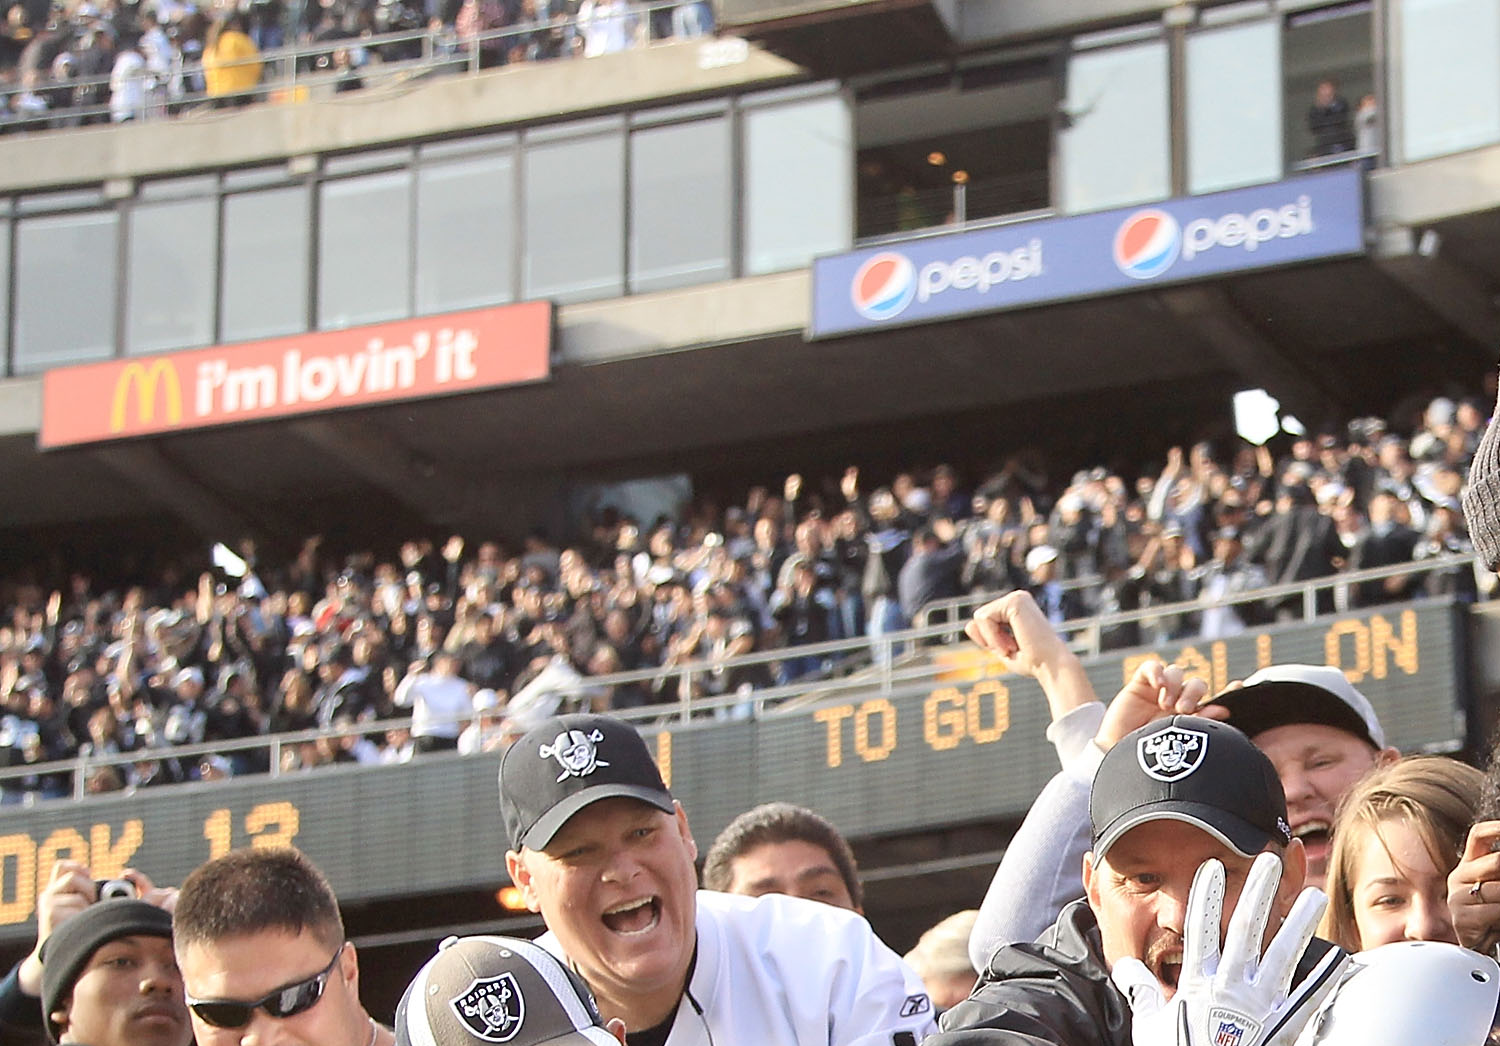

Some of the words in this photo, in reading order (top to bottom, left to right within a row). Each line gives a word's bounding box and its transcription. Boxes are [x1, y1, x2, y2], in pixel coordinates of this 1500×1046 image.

[1182, 195, 1312, 260] pepsi
[918, 238, 1043, 302] pepsi
[195, 359, 278, 417] i'm
[281, 331, 431, 405] lovin'
[434, 329, 478, 383] it
[1325, 610, 1418, 684] ON
[814, 698, 897, 769] TO
[924, 680, 1010, 751] GO
[459, 979, 507, 1008] RAIDERS
[1212, 1010, 1256, 1032] EQUIPMENT
